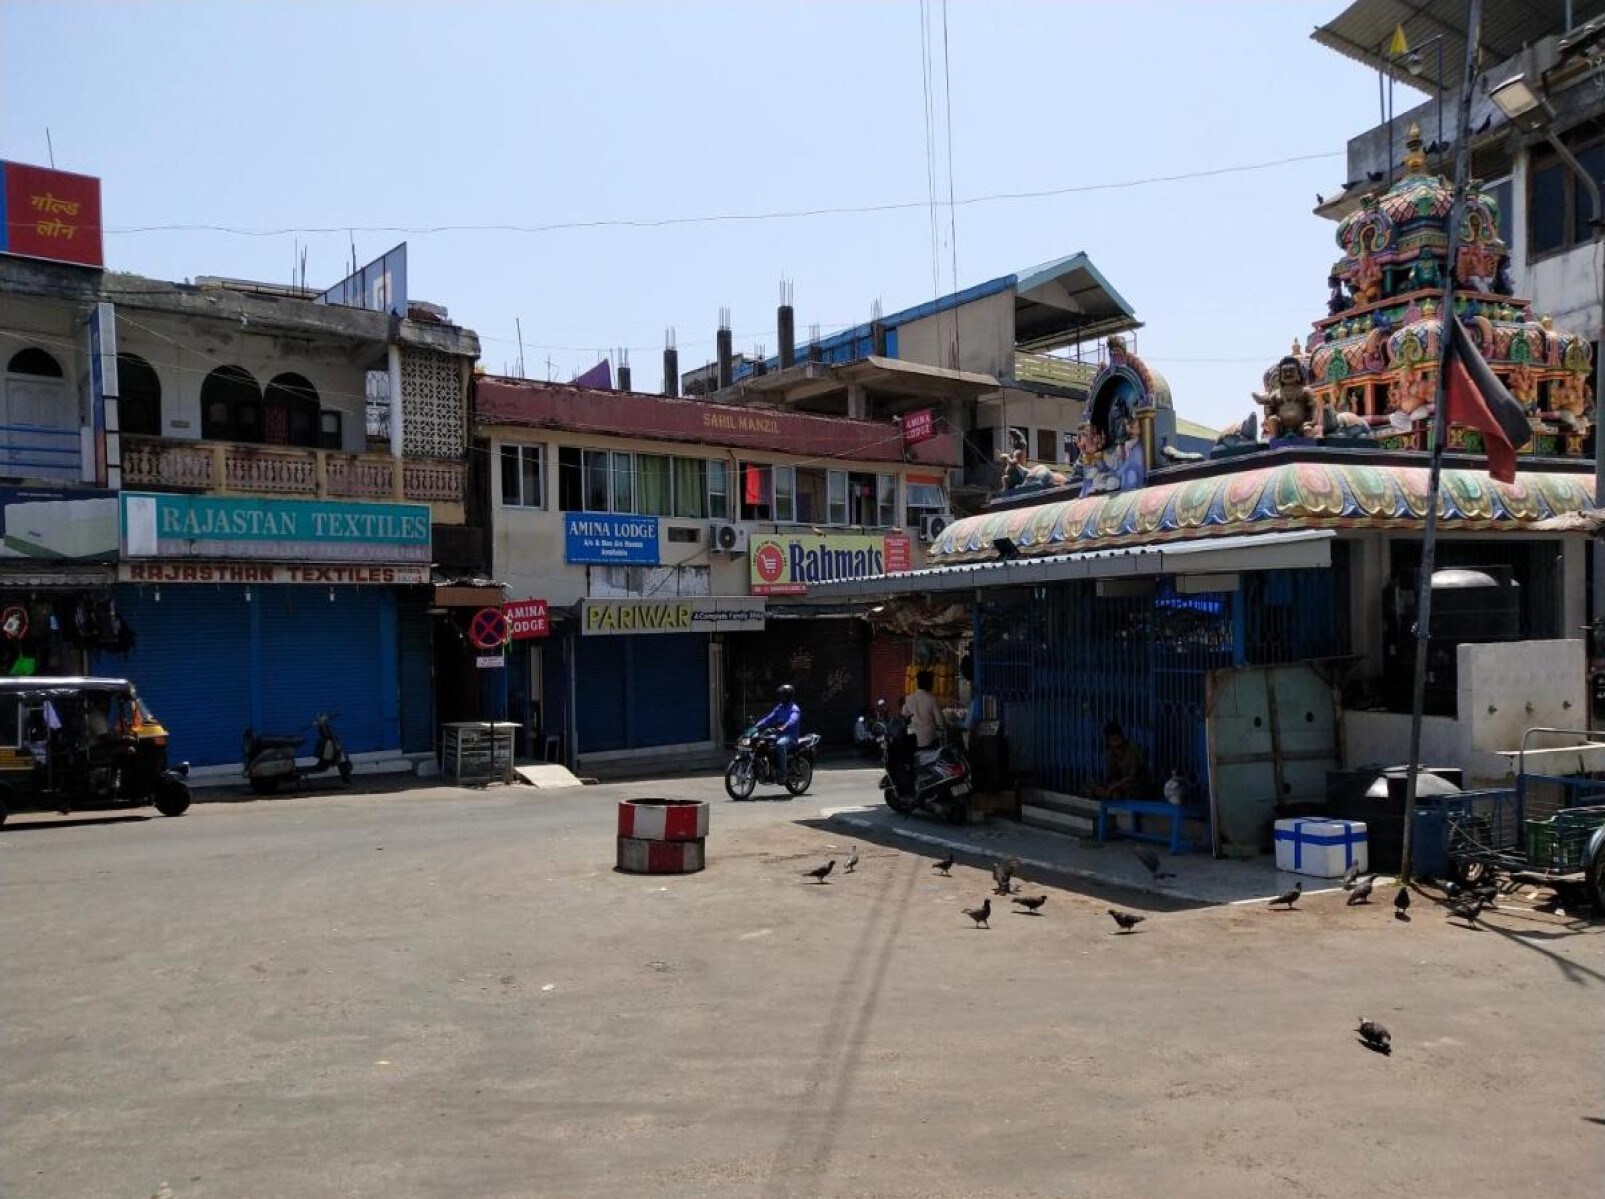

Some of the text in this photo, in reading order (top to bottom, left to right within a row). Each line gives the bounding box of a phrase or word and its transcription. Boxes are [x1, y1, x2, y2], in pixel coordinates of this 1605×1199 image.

[31, 192, 81, 216] गोल्ड
[37, 218, 76, 239] लोन
[162, 506, 427, 539] RAJASTAN TEXTILES
[569, 521, 655, 538] AMINA LODGE
[130, 565, 274, 581] RAJASTHAN
[287, 568, 395, 582] TEXTILES
[789, 543, 884, 582] Rahmats
[507, 605, 546, 619] AMINA
[588, 604, 691, 629] PARIWAR
